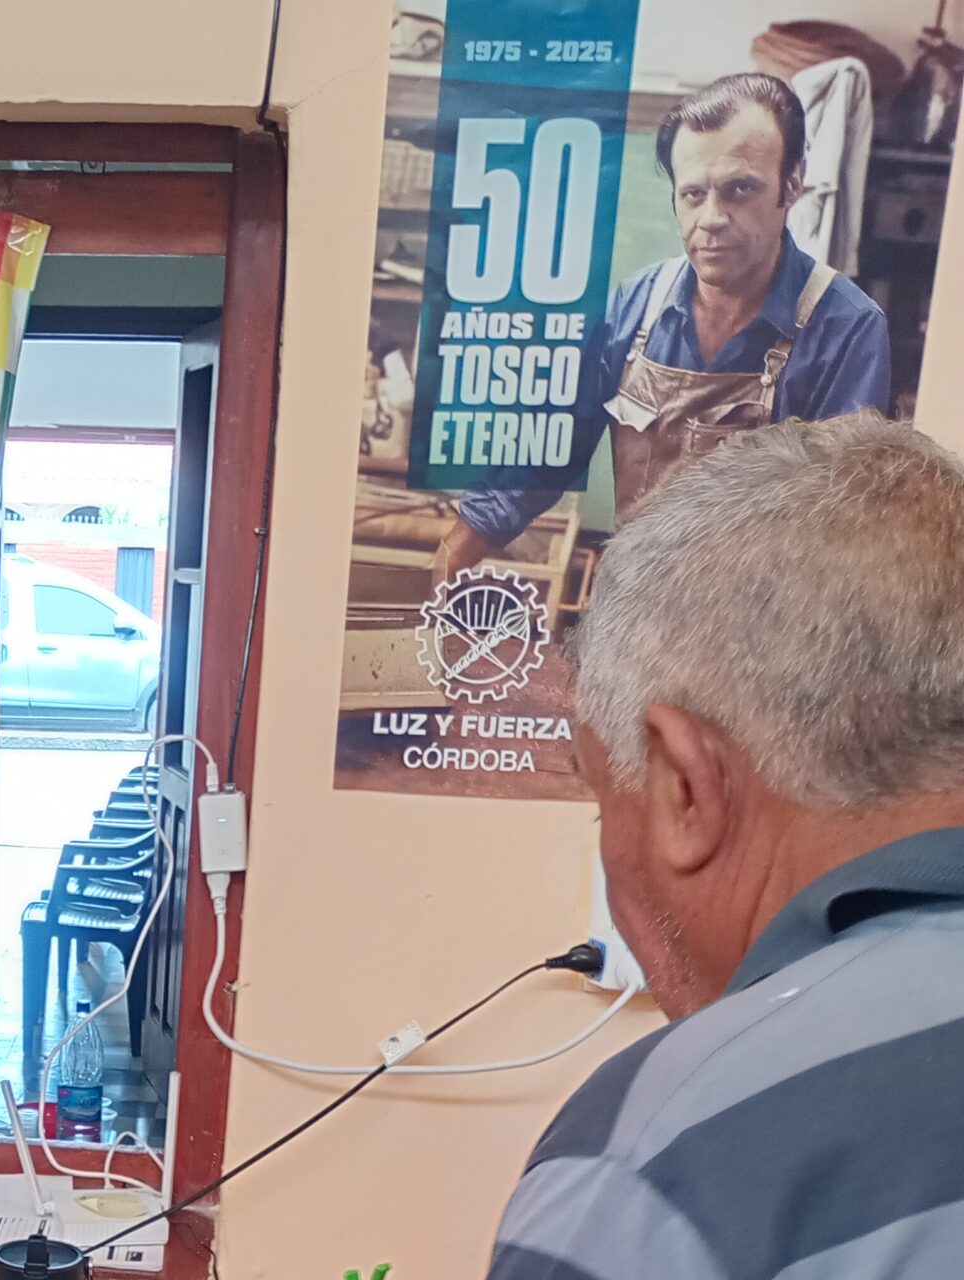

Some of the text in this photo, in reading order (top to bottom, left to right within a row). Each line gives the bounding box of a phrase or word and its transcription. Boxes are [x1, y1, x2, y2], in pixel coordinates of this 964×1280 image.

[464, 40, 521, 62] 1975
[545, 41, 613, 62] 2025
[446, 118, 602, 304] 50
[440, 306, 585, 340] AÑOS DE
[438, 345, 581, 406] TOSCO
[429, 411, 574, 467] ETERNO
[372, 712, 572, 741] LUZ Y FUERZA
[403, 742, 535, 772] CÓRDOBA
